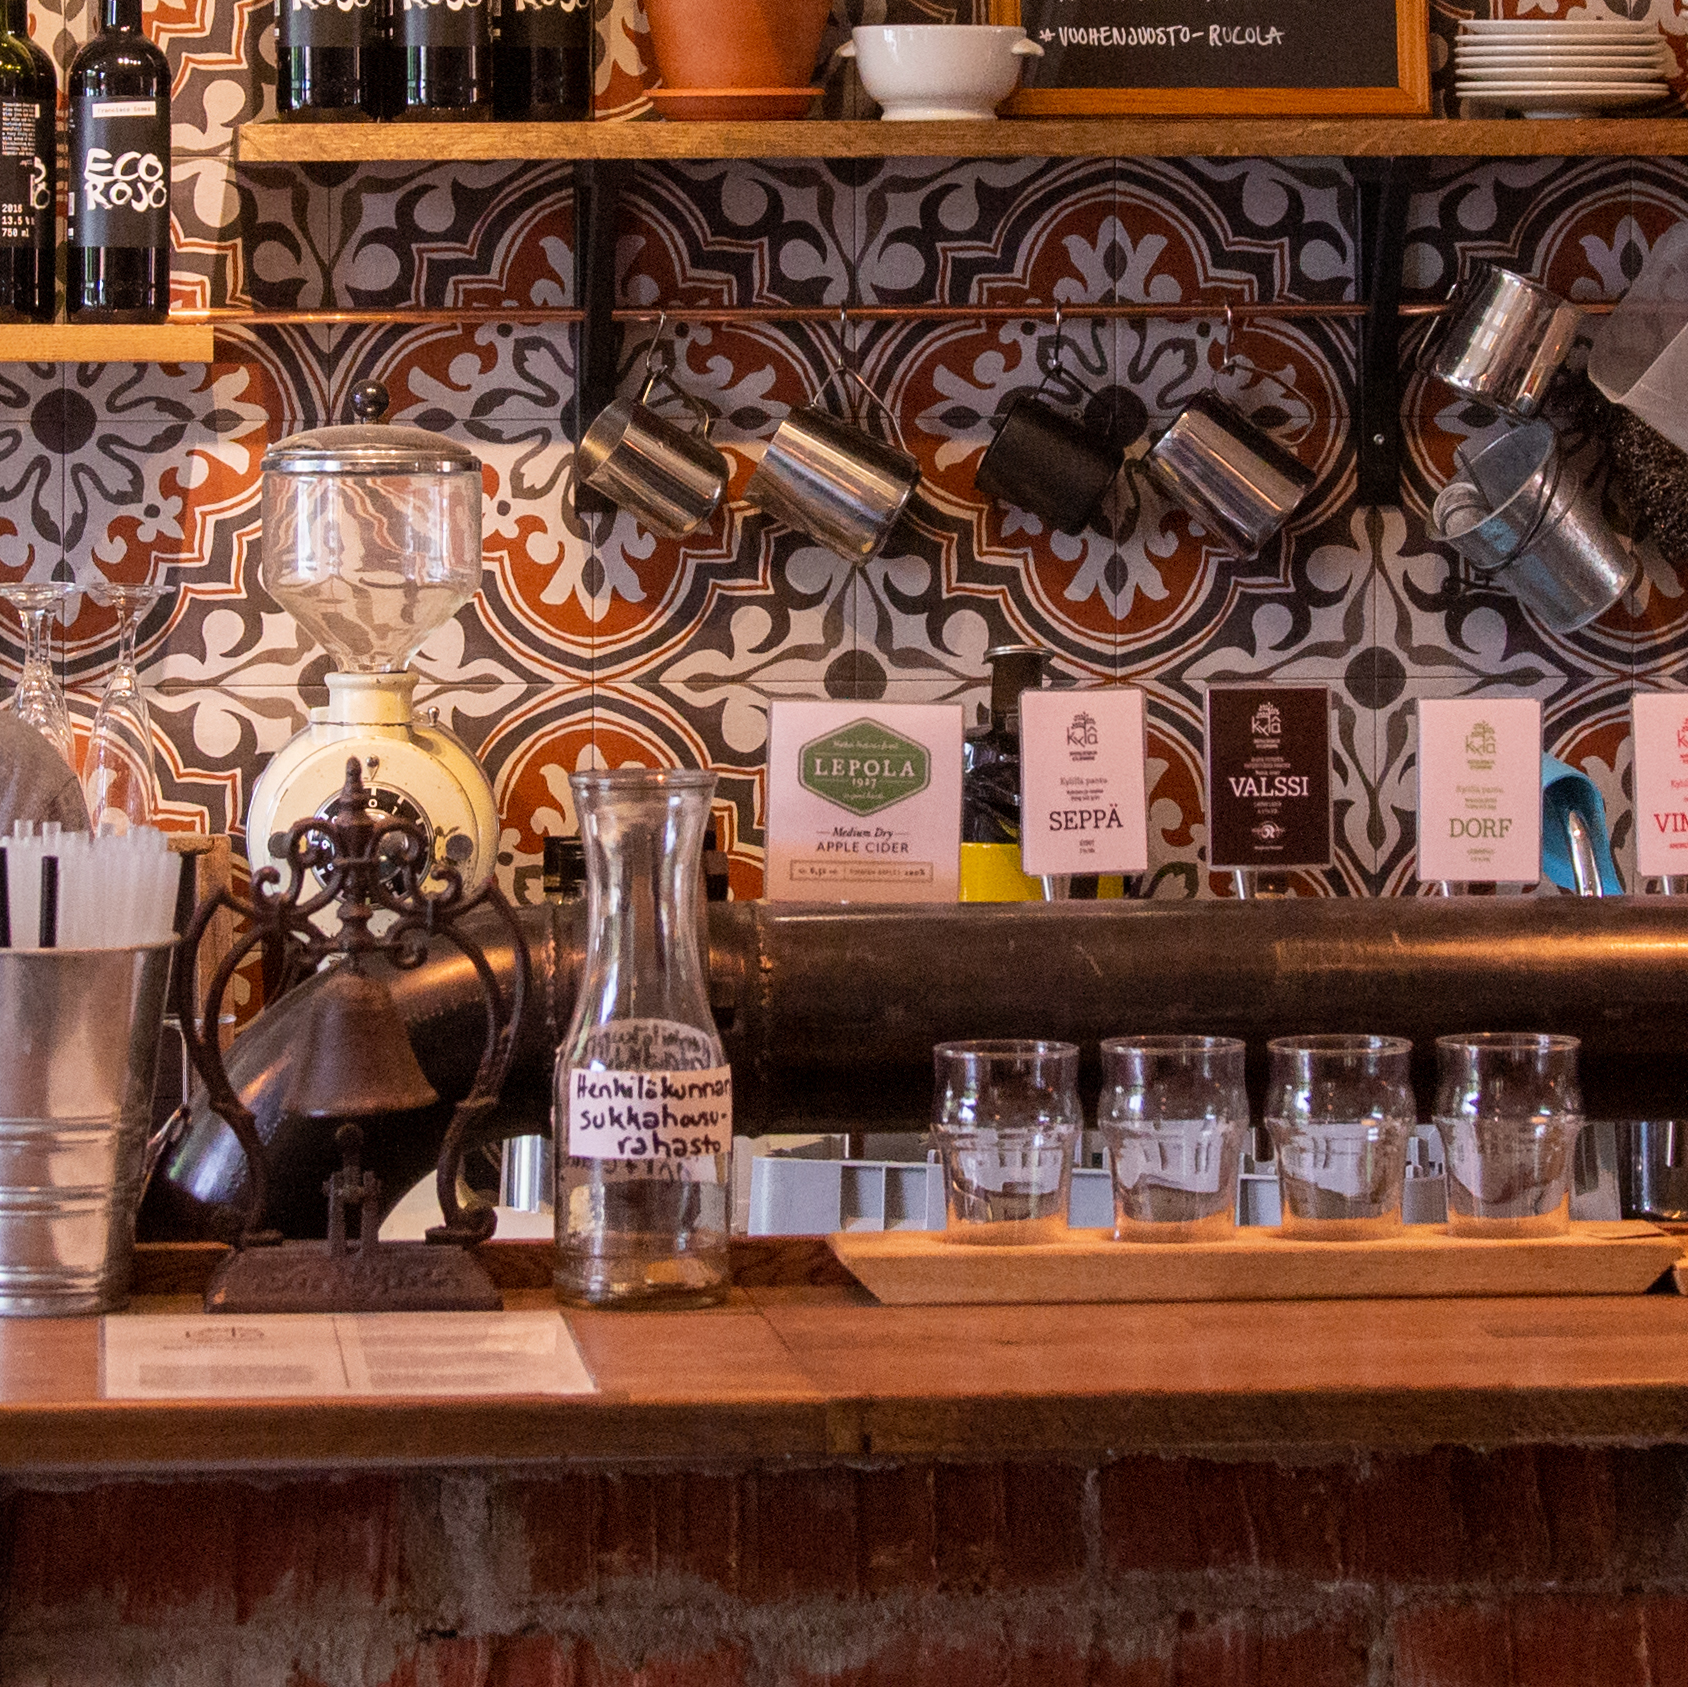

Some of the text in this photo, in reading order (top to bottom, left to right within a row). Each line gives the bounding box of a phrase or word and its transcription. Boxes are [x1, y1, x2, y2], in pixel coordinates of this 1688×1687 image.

[84, 148, 164, 184] ECO
[84, 180, 168, 213] ROJO
[814, 758, 915, 778] LEPOLA
[1228, 776, 1309, 798] VALSSI
[1049, 803, 1124, 832] SEPPÄ
[1449, 817, 1513, 839] DORF
[832, 826, 895, 841] Medium Dry
[816, 841, 909, 854] APPLE CIDER
[616, 1129, 721, 1158] rahasto
